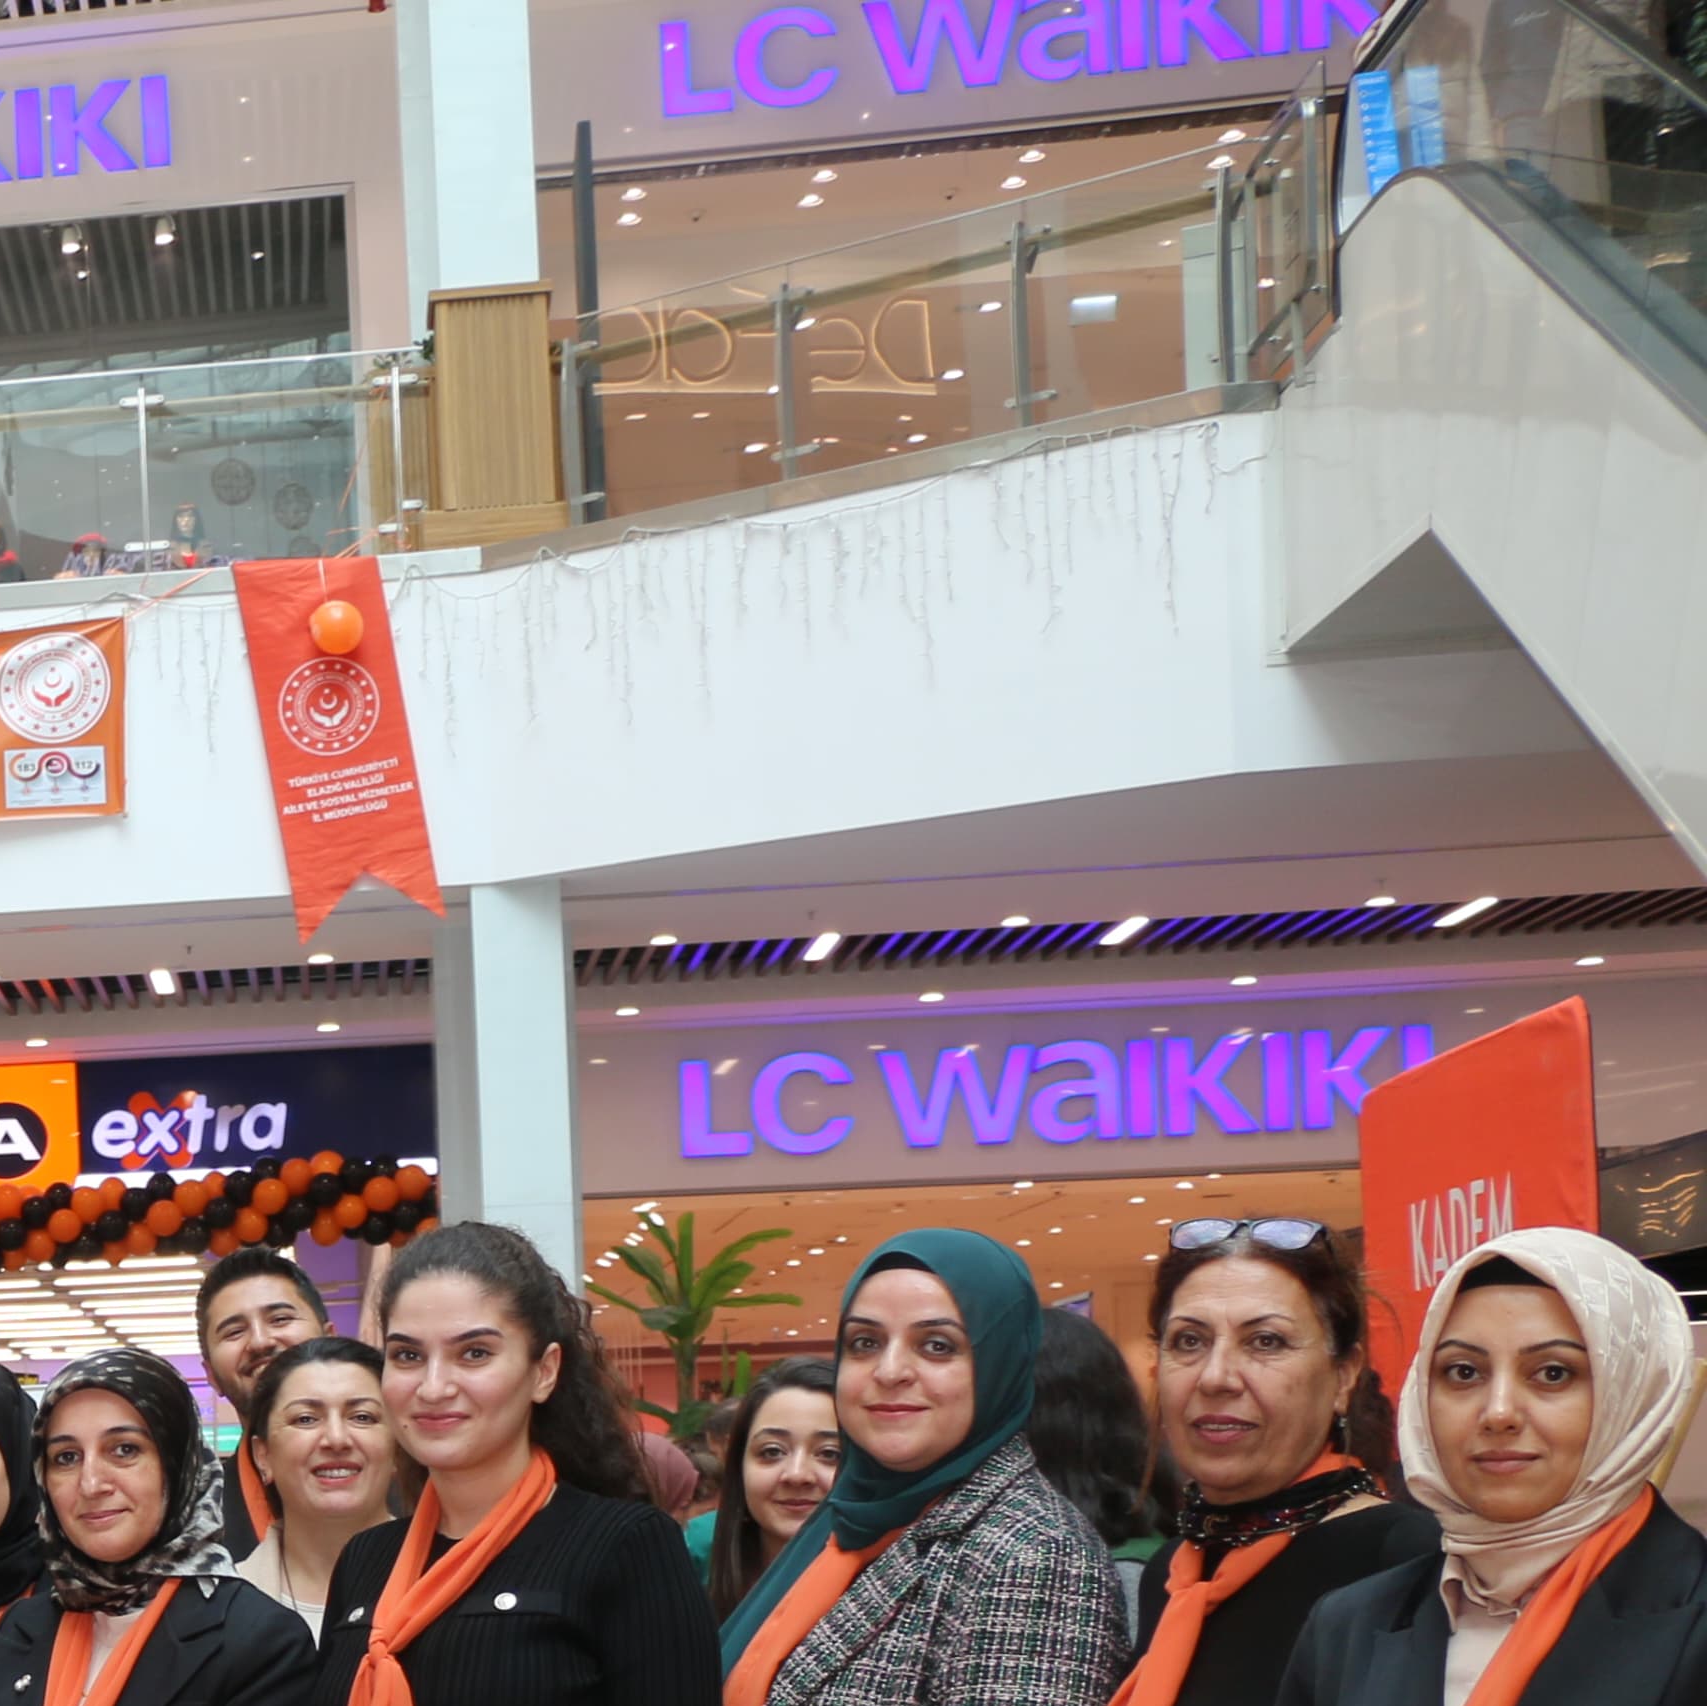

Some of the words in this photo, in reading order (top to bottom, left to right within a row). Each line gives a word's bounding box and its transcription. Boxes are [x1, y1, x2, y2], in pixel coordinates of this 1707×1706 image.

[659, 8, 841, 117] LC
[91, 1092, 287, 1158] extra
[679, 1050, 855, 1159] LC
[1408, 1170, 1514, 1292] KADEM
